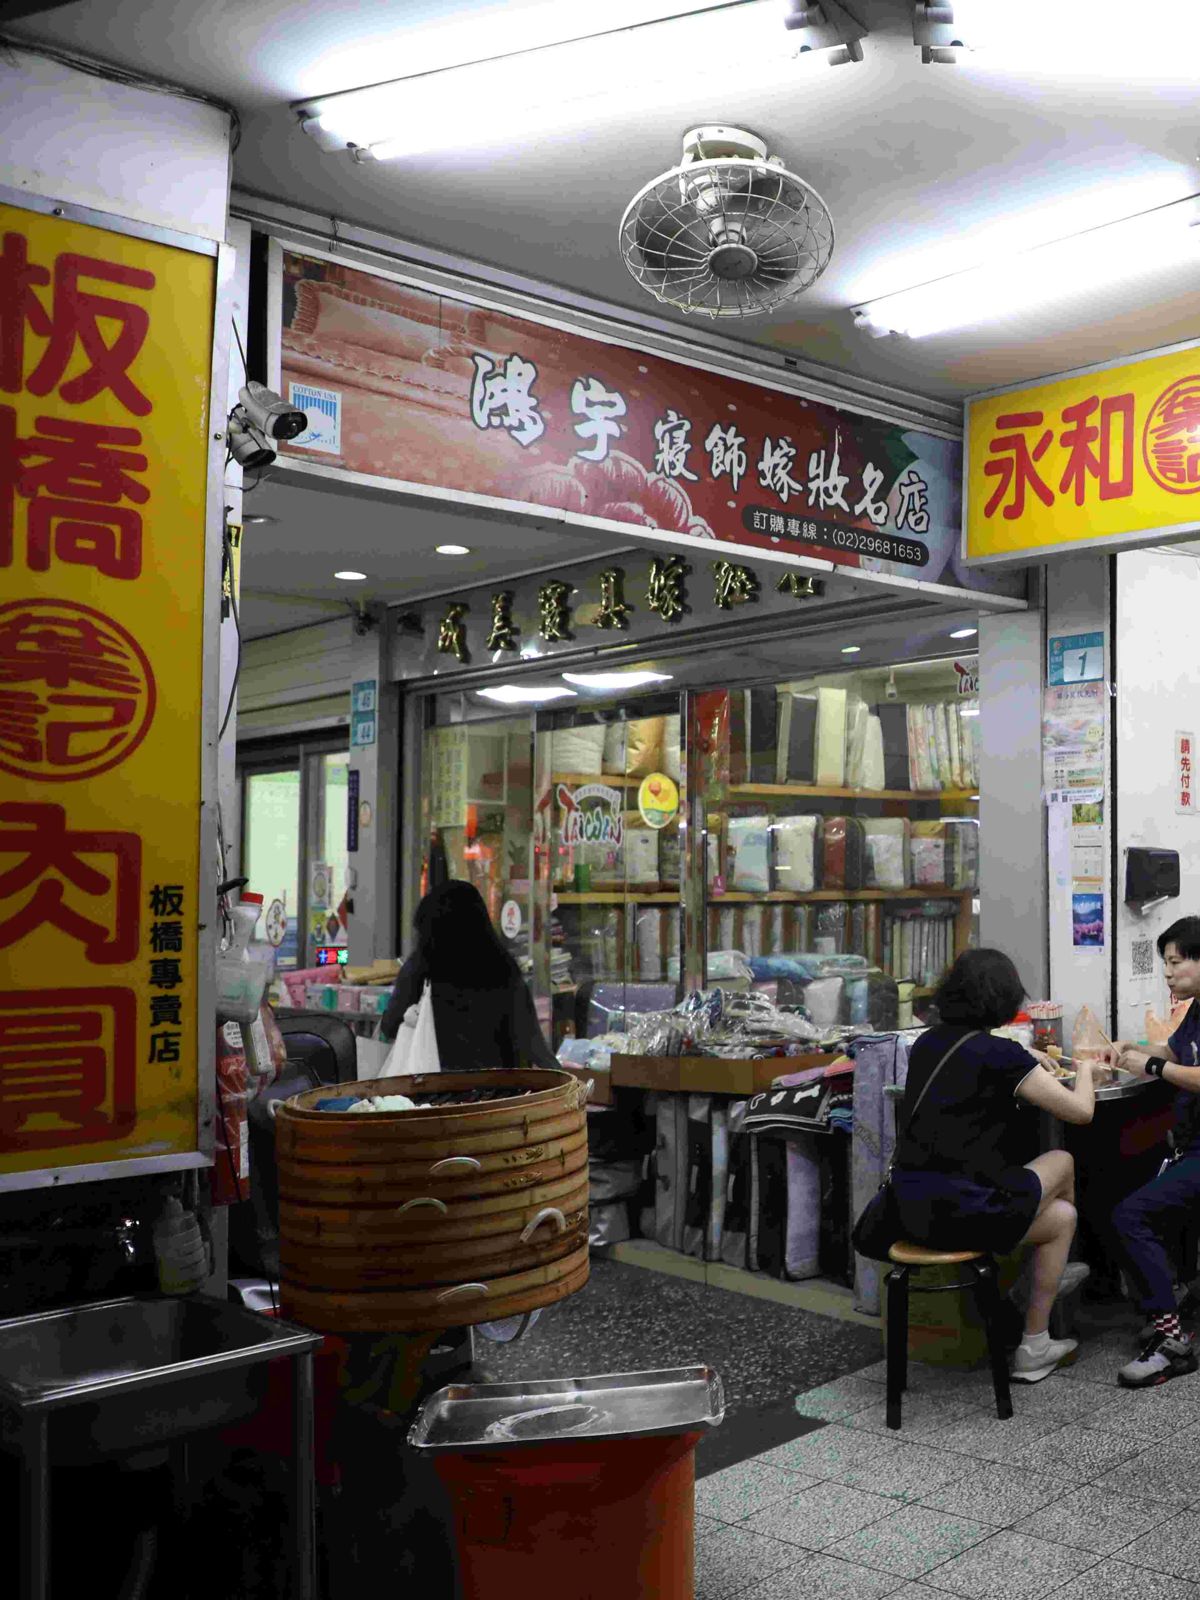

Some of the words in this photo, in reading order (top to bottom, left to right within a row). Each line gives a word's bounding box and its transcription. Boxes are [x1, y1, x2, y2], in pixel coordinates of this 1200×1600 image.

[293, 385, 322, 397] COTTON
[324, 392, 337, 401] USA
[1180, 738, 1191, 806] 請先付款
[148, 884, 184, 1064] 板橋專賣店
